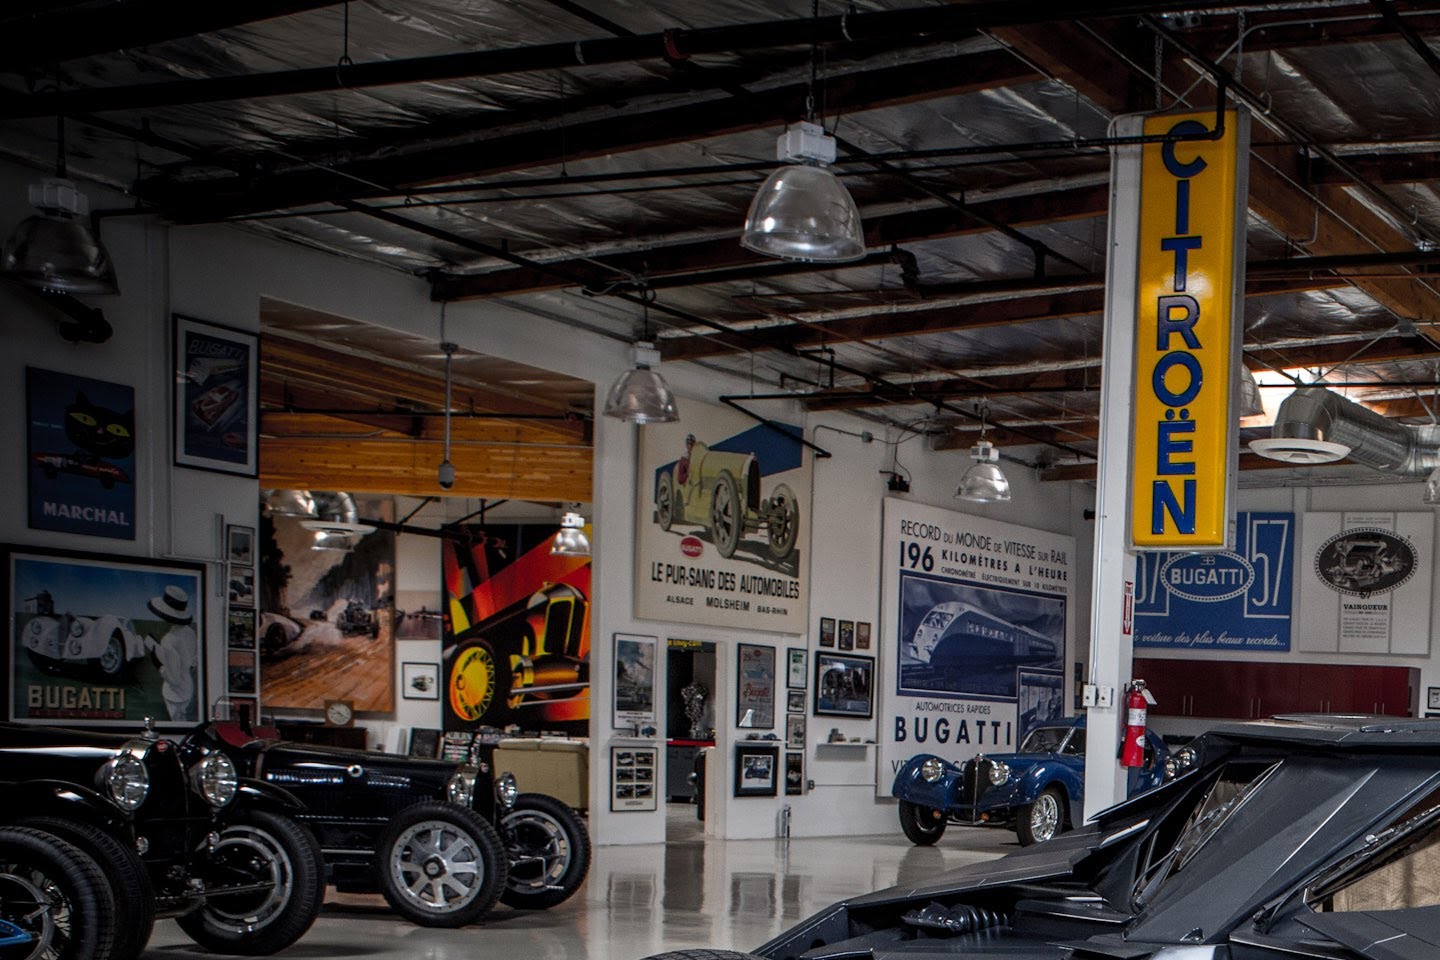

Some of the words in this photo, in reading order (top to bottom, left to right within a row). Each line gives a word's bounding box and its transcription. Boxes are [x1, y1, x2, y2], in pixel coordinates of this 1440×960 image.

[1152, 120, 1210, 535] CITROËN
[43, 501, 130, 526] MARCHAL
[901, 520, 941, 540] RECORD
[955, 533, 992, 551] MONDE
[1004, 540, 1036, 560] VITESSE
[1051, 550, 1068, 566] RAIL
[900, 541, 935, 572] 196
[1251, 519, 1289, 607] 57
[652, 562, 663, 582] LE
[666, 564, 715, 590] PUR-SANG
[718, 570, 736, 592] DES
[740, 574, 800, 599] AUTOMOBILES
[1029, 566, 1068, 582] L'HEURE
[1170, 568, 1244, 585] BUGATTI
[667, 595, 694, 606] ALSACE
[706, 597, 750, 612] MOLSHEIM
[1343, 603, 1388, 611] VAINQUEUR
[1142, 632, 1173, 643] voiture
[1174, 631, 1190, 643] des
[1190, 629, 1215, 647] plus
[1216, 631, 1244, 646] beaux
[28, 685, 126, 710] BUGATTI
[916, 701, 965, 713] AUTOMOTRICES
[966, 704, 991, 715] RAPIDES
[895, 716, 1011, 746] BUGATTI
